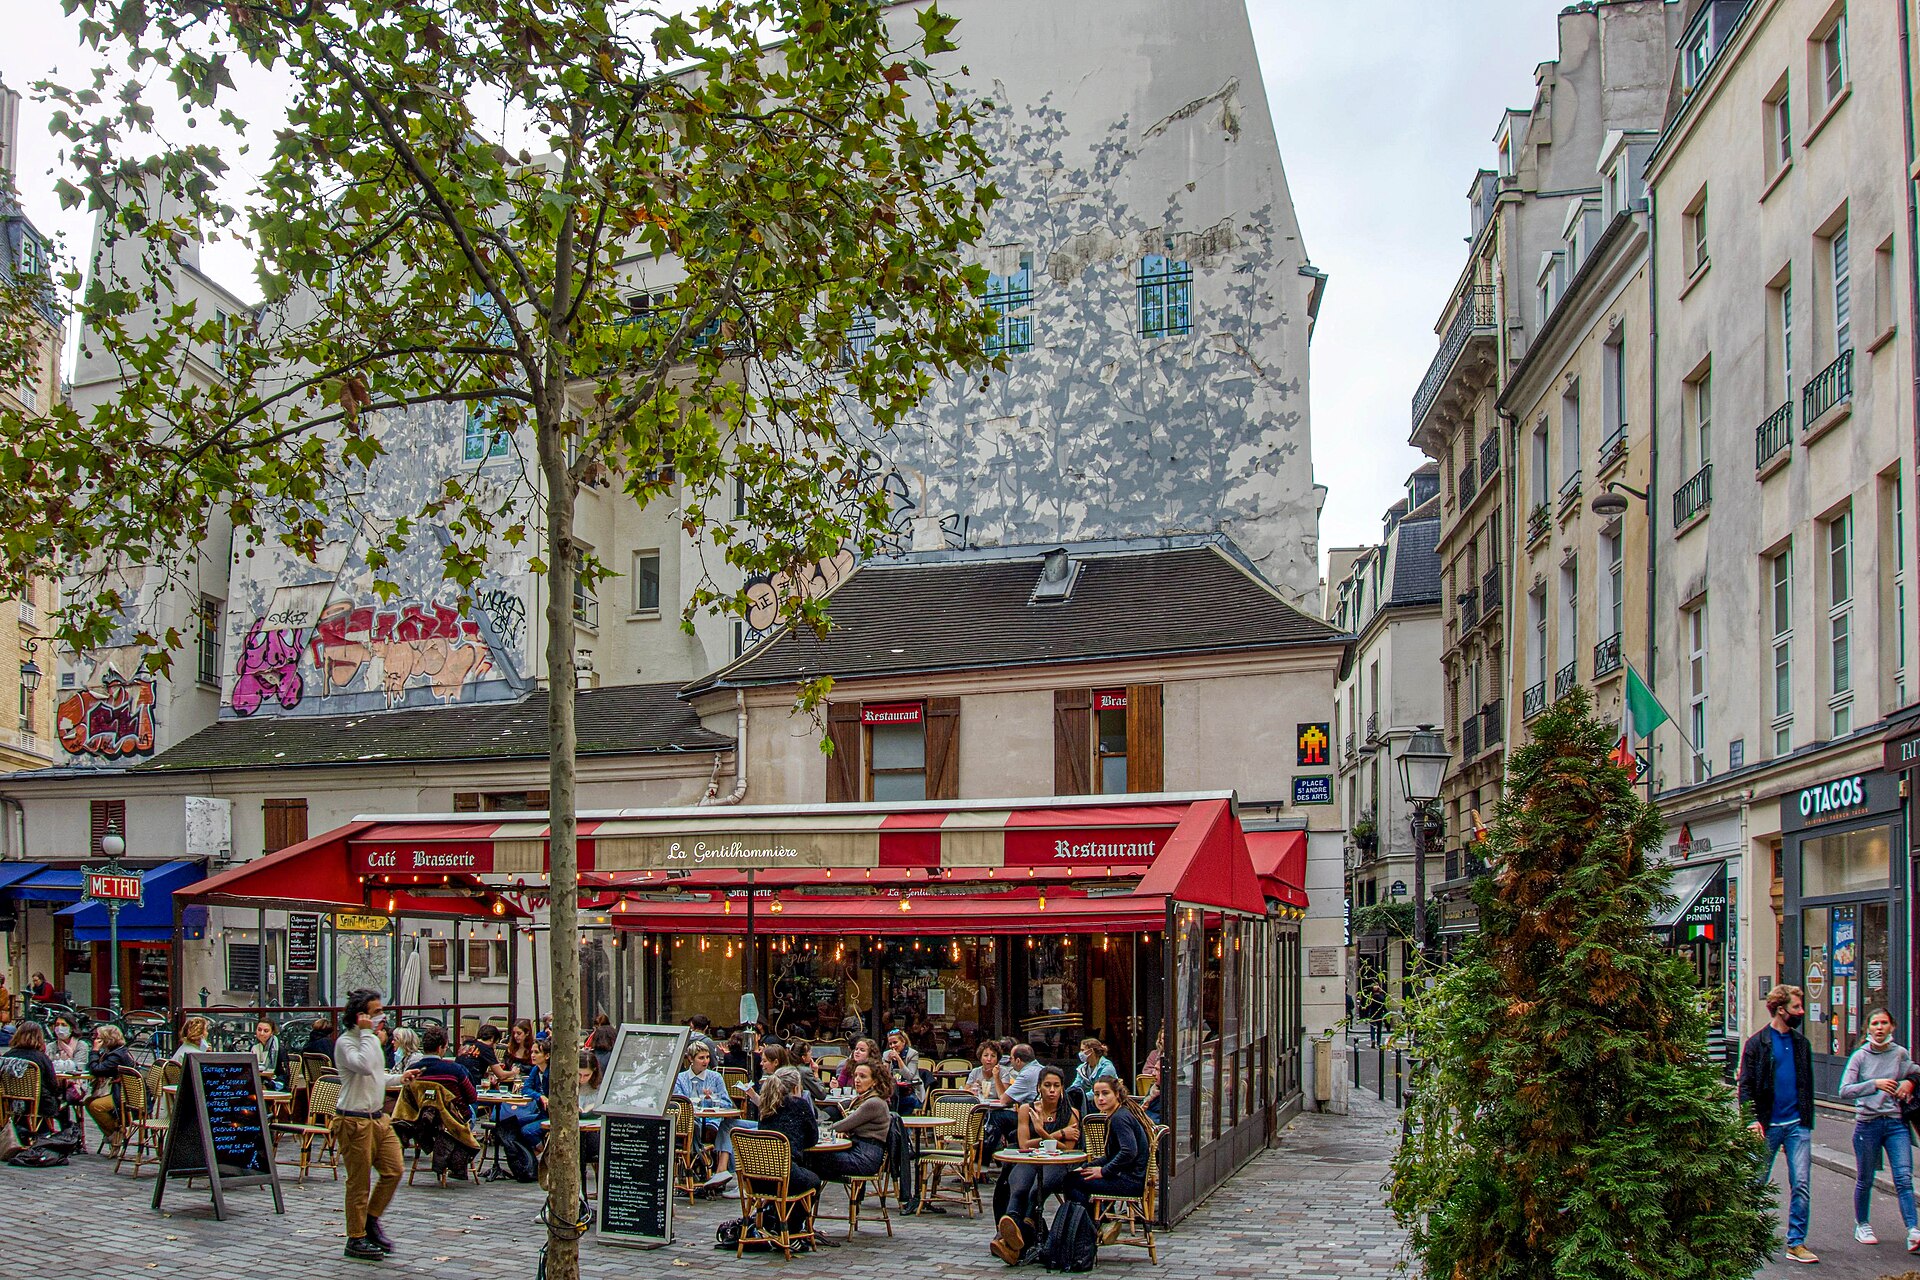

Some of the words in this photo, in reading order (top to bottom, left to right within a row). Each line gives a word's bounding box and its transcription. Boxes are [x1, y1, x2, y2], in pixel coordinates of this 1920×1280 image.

[864, 710, 919, 721] Restaurant
[1305, 786, 1327, 794] ANDRÉ
[1800, 776, 1863, 816] O'TACOS
[1829, 812, 1849, 821] FRENCH
[1852, 807, 1869, 817] TACOS
[666, 842, 688, 860] La
[694, 841, 799, 863] Gentilhommière
[1053, 839, 1156, 859] Restaurant
[368, 850, 397, 867] Café
[412, 850, 476, 869] Brasserie
[92, 876, 139, 897] METRO
[728, 889, 772, 897] Braserie
[1702, 896, 1726, 904] PIZZA
[1694, 904, 1721, 913] PASTA
[1686, 913, 1712, 922] PANINI
